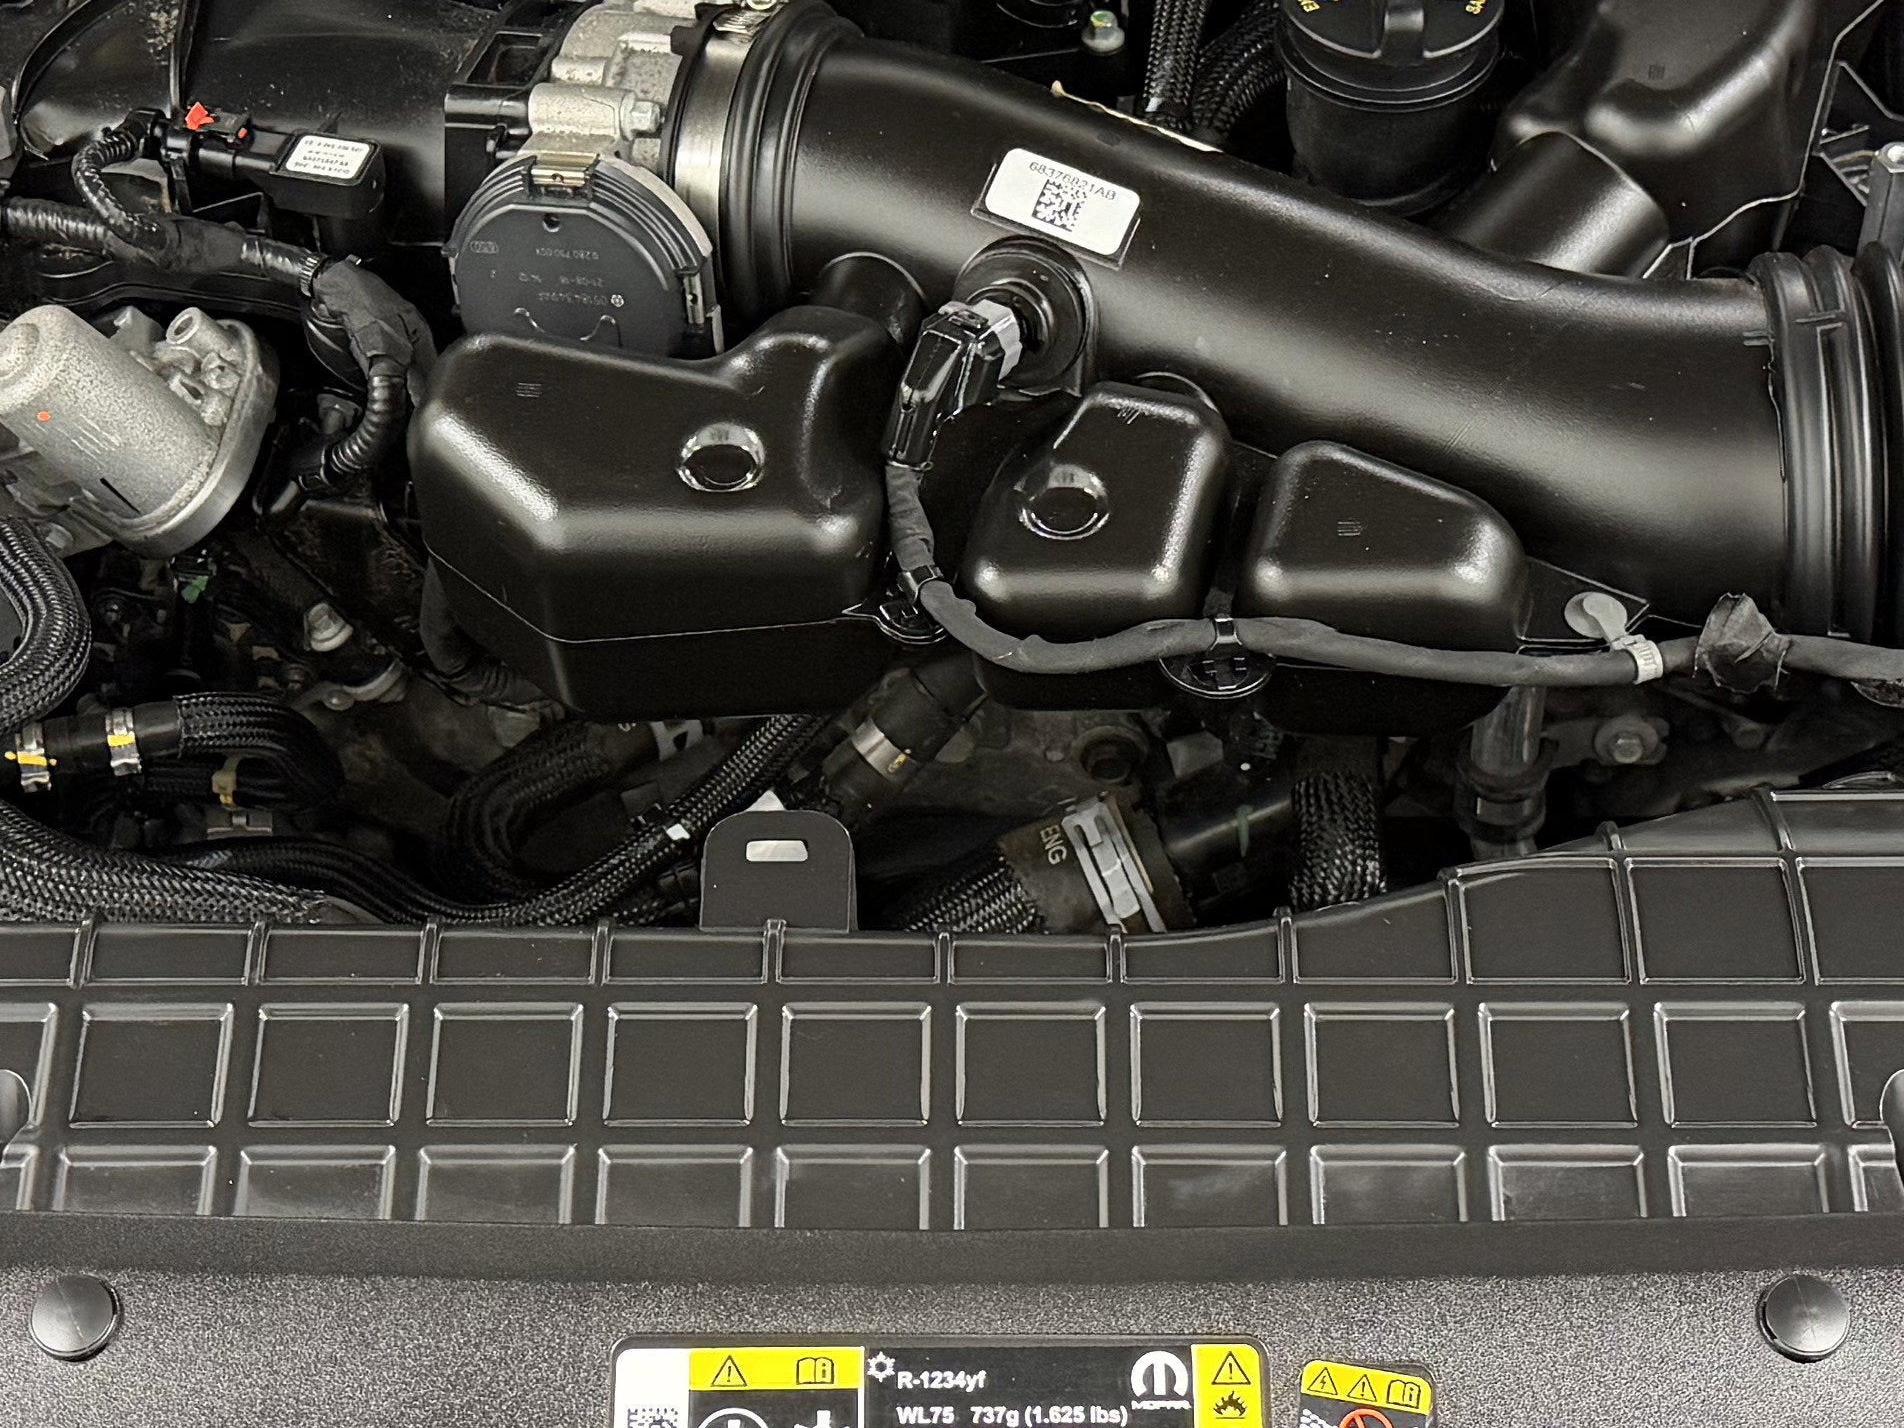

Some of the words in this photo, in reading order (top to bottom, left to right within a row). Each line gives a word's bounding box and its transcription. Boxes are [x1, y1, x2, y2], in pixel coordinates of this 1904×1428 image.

[1040, 824, 1068, 865] ENG
[897, 1369, 987, 1393] R-1234yf
[896, 1406, 955, 1425] WL75
[970, 1406, 1020, 1428] 737g
[1024, 1405, 1086, 1427] (1.625
[1090, 1405, 1129, 1427] lbs)
